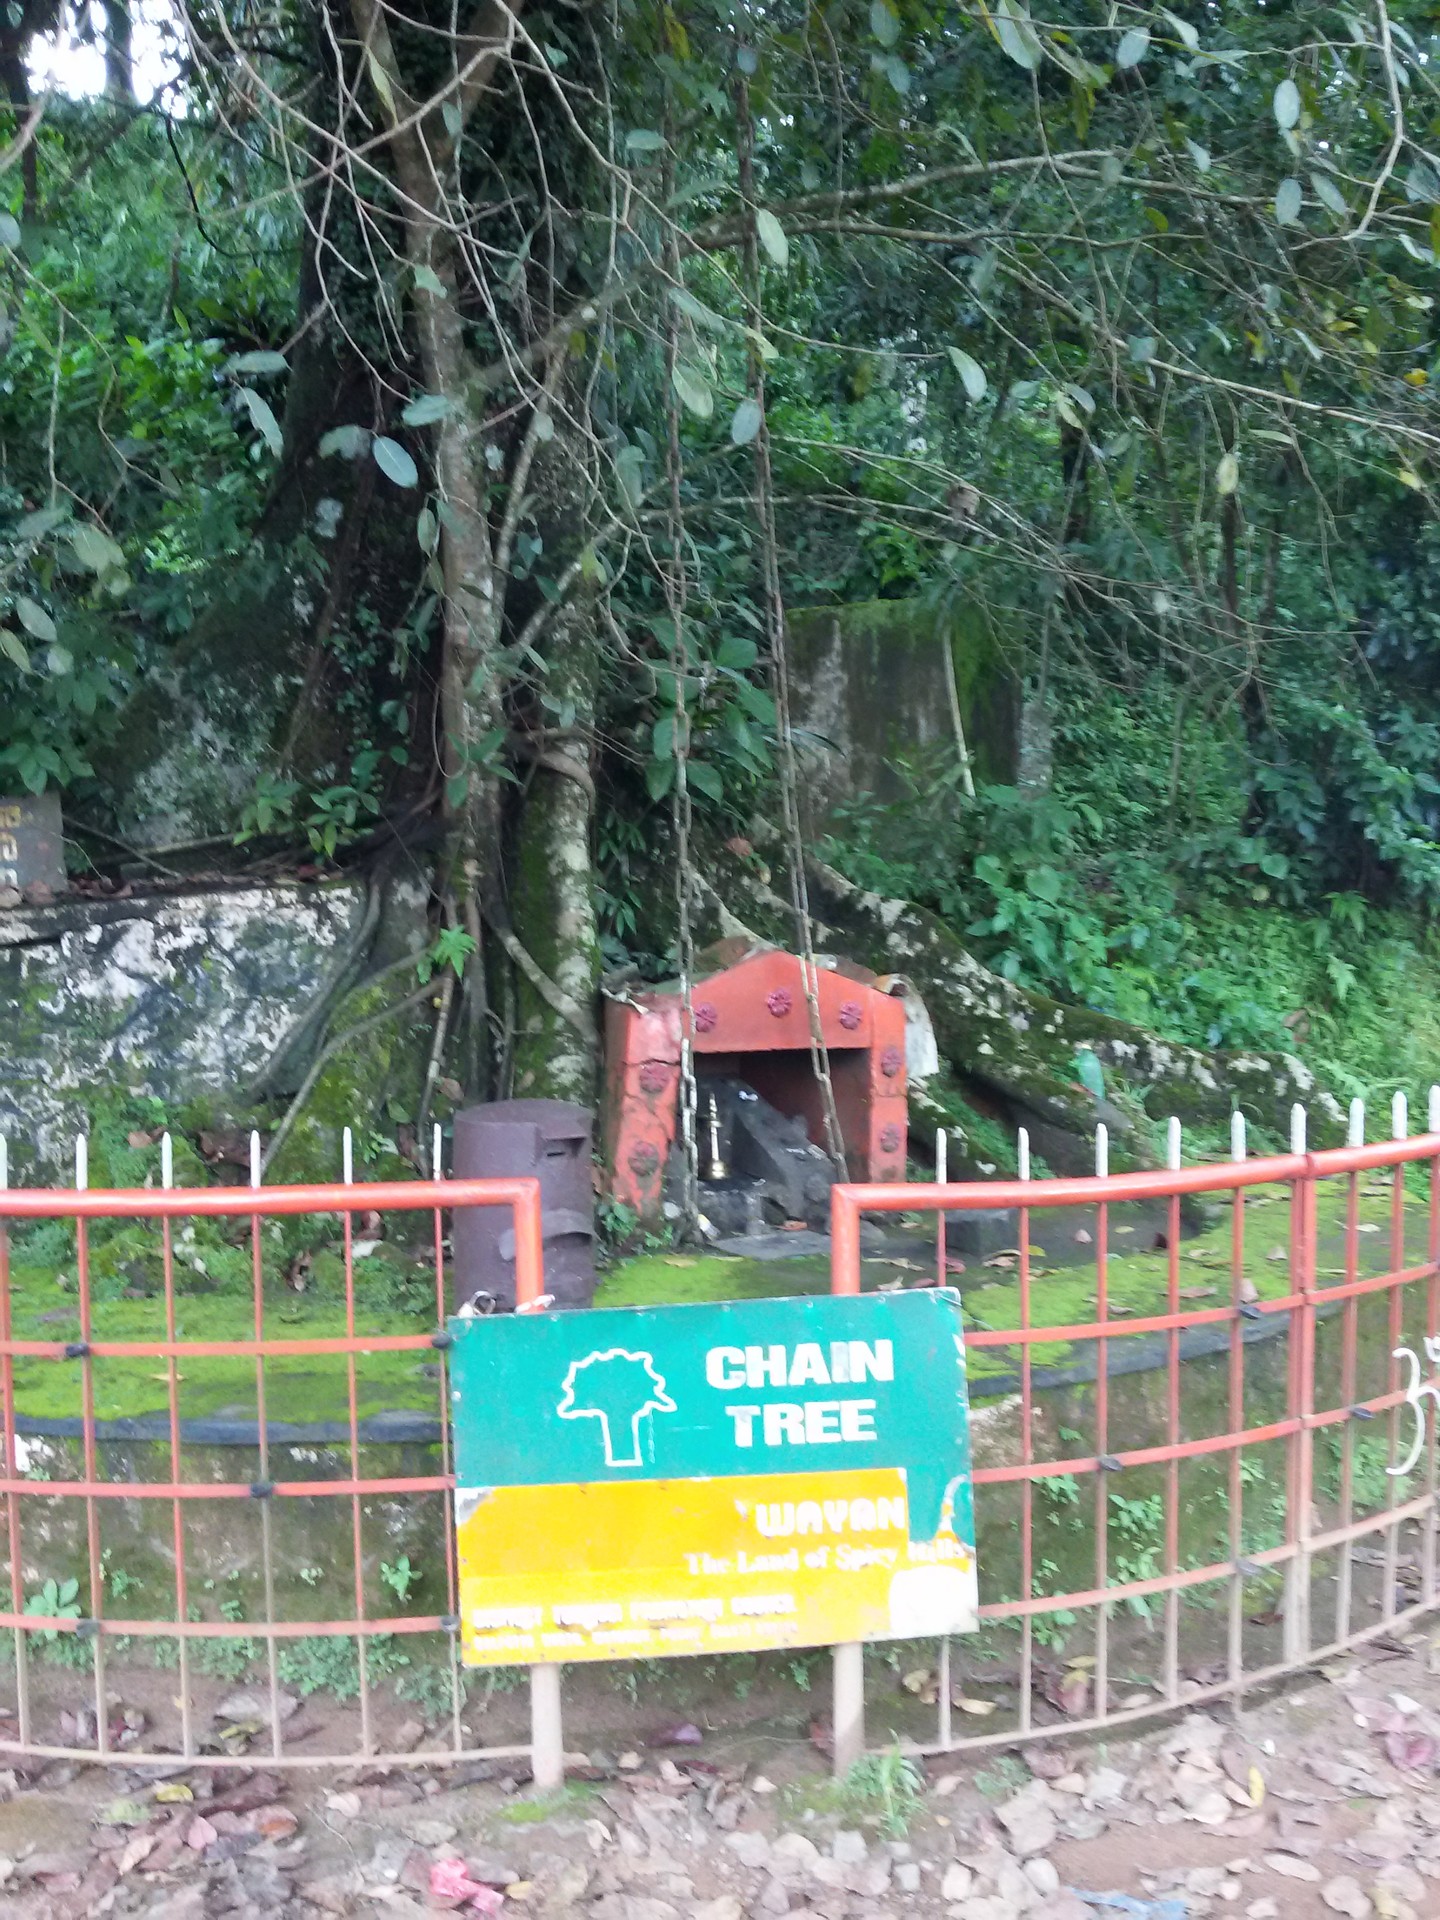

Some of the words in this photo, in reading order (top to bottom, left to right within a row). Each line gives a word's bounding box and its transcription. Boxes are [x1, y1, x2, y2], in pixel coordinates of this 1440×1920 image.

[706, 1339, 895, 1390] CHAIN
[725, 1399, 878, 1448] TREE
[685, 1552, 731, 1576] The
[737, 1548, 800, 1575] Land
[804, 1546, 831, 1570] of
[835, 1544, 898, 1572] Spicy
